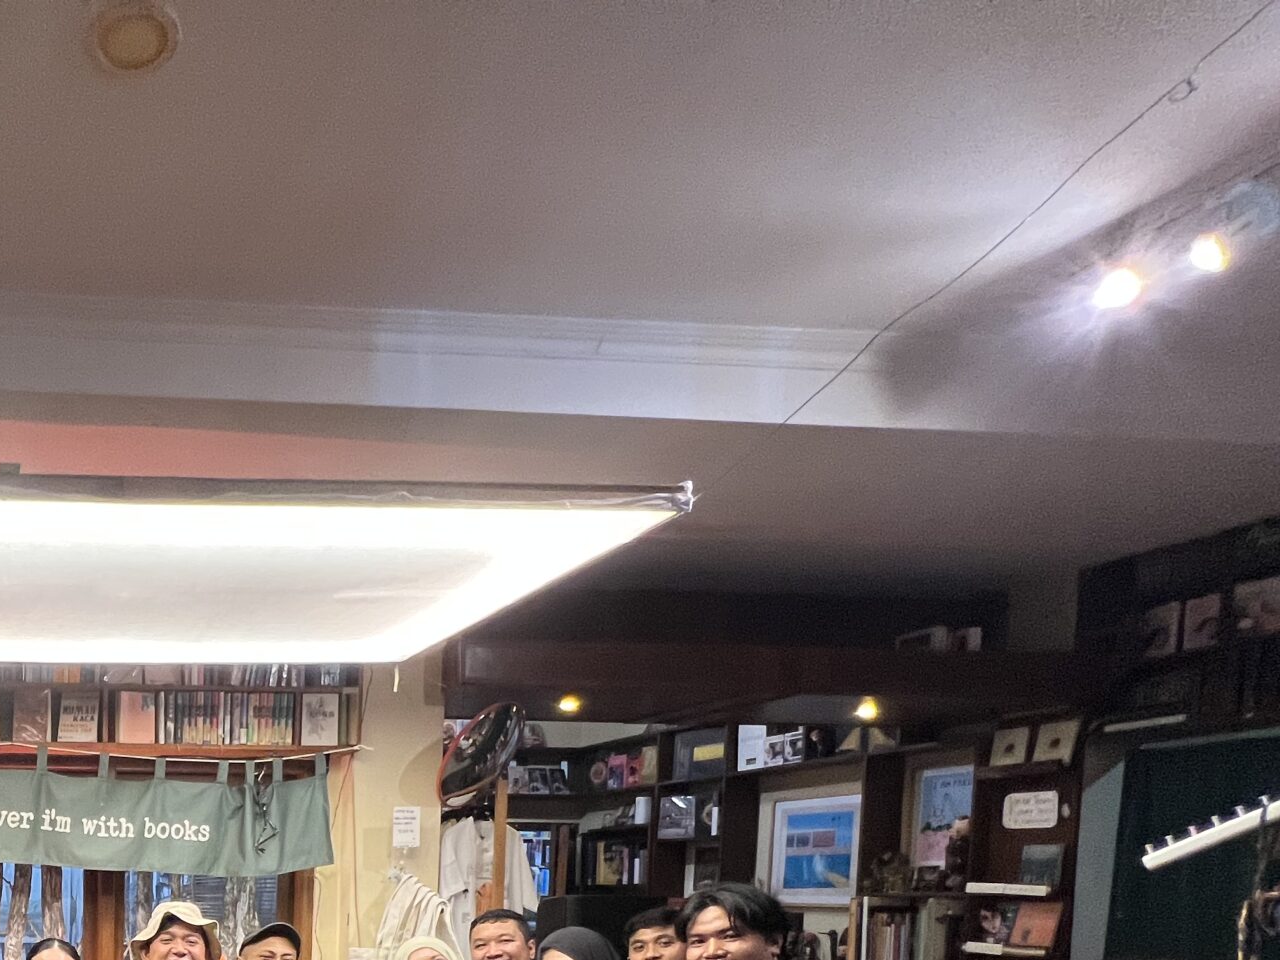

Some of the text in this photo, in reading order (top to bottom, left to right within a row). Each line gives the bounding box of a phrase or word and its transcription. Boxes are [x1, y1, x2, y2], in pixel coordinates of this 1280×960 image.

[40, 808, 71, 833] i'm
[81, 815, 135, 839] with
[143, 817, 210, 843] books
